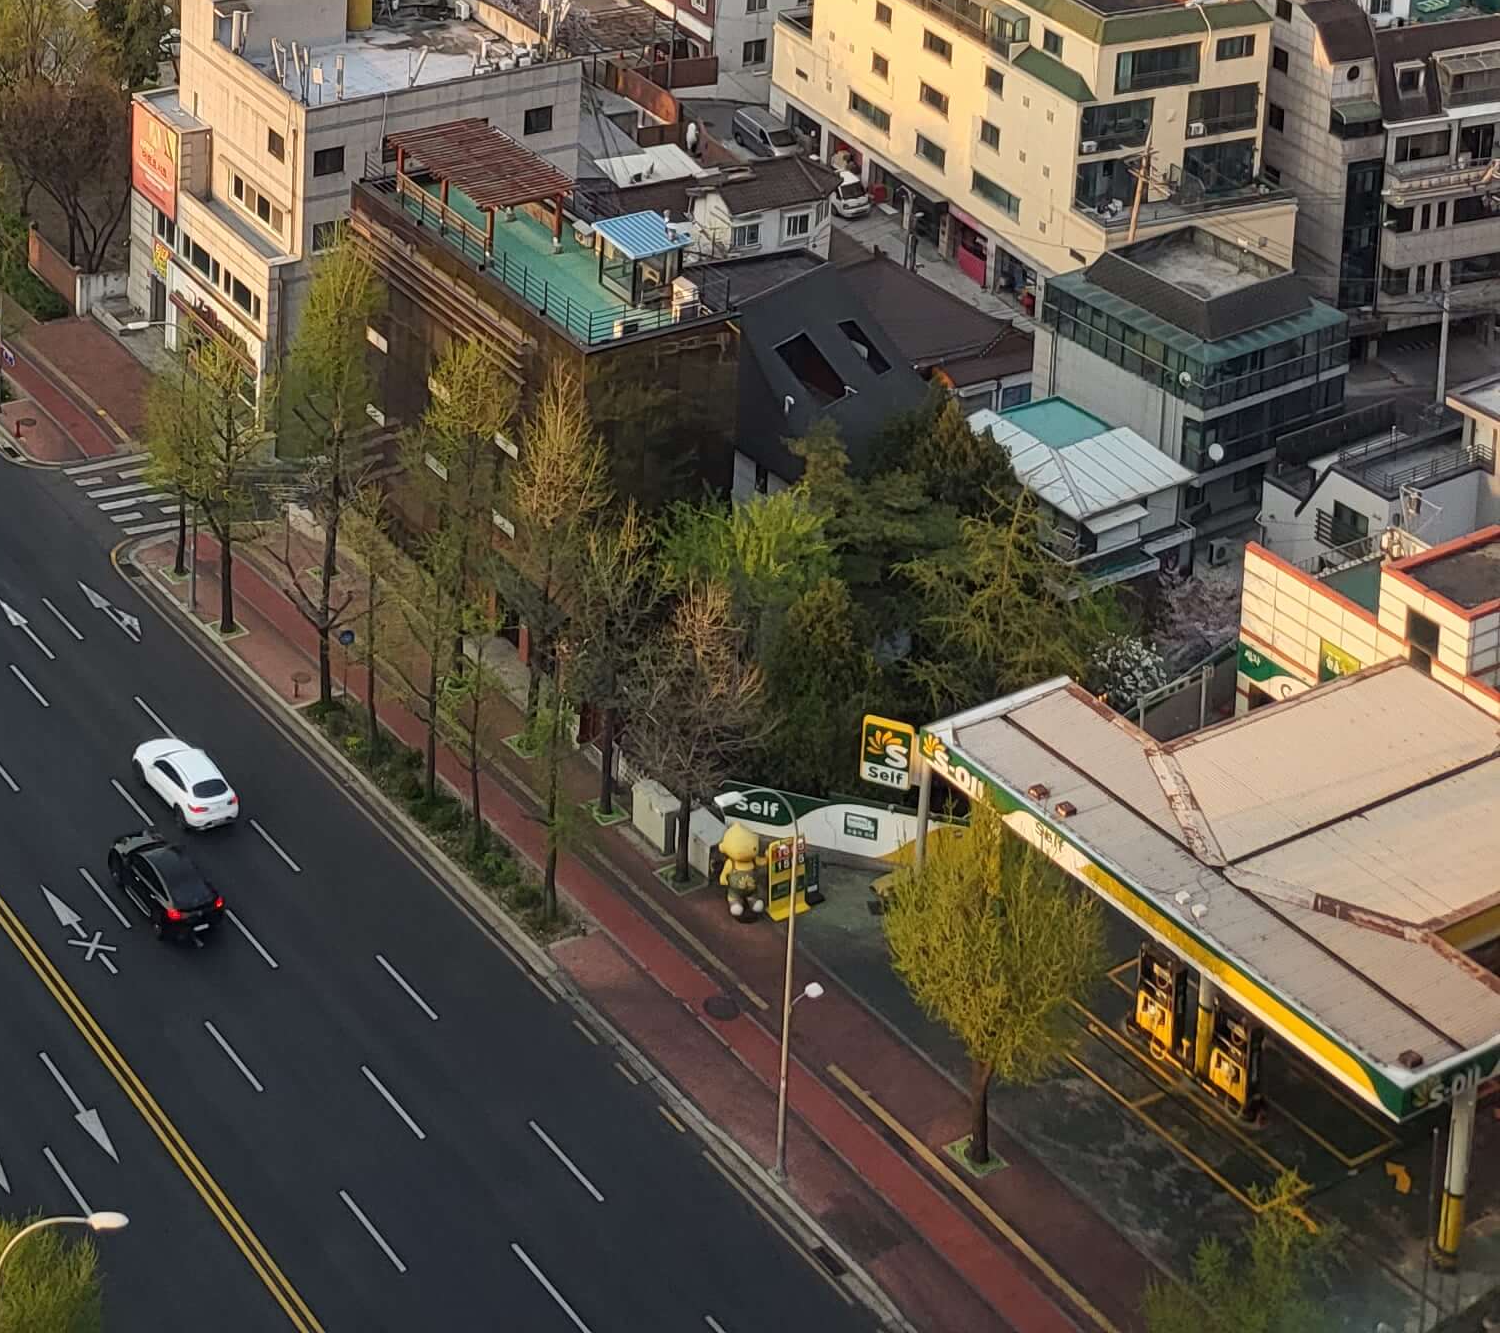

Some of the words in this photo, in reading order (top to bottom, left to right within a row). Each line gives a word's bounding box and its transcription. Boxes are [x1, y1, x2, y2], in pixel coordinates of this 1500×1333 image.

[867, 764, 905, 785] Self
[933, 749, 985, 800] S-OIL
[735, 796, 781, 818] Self
